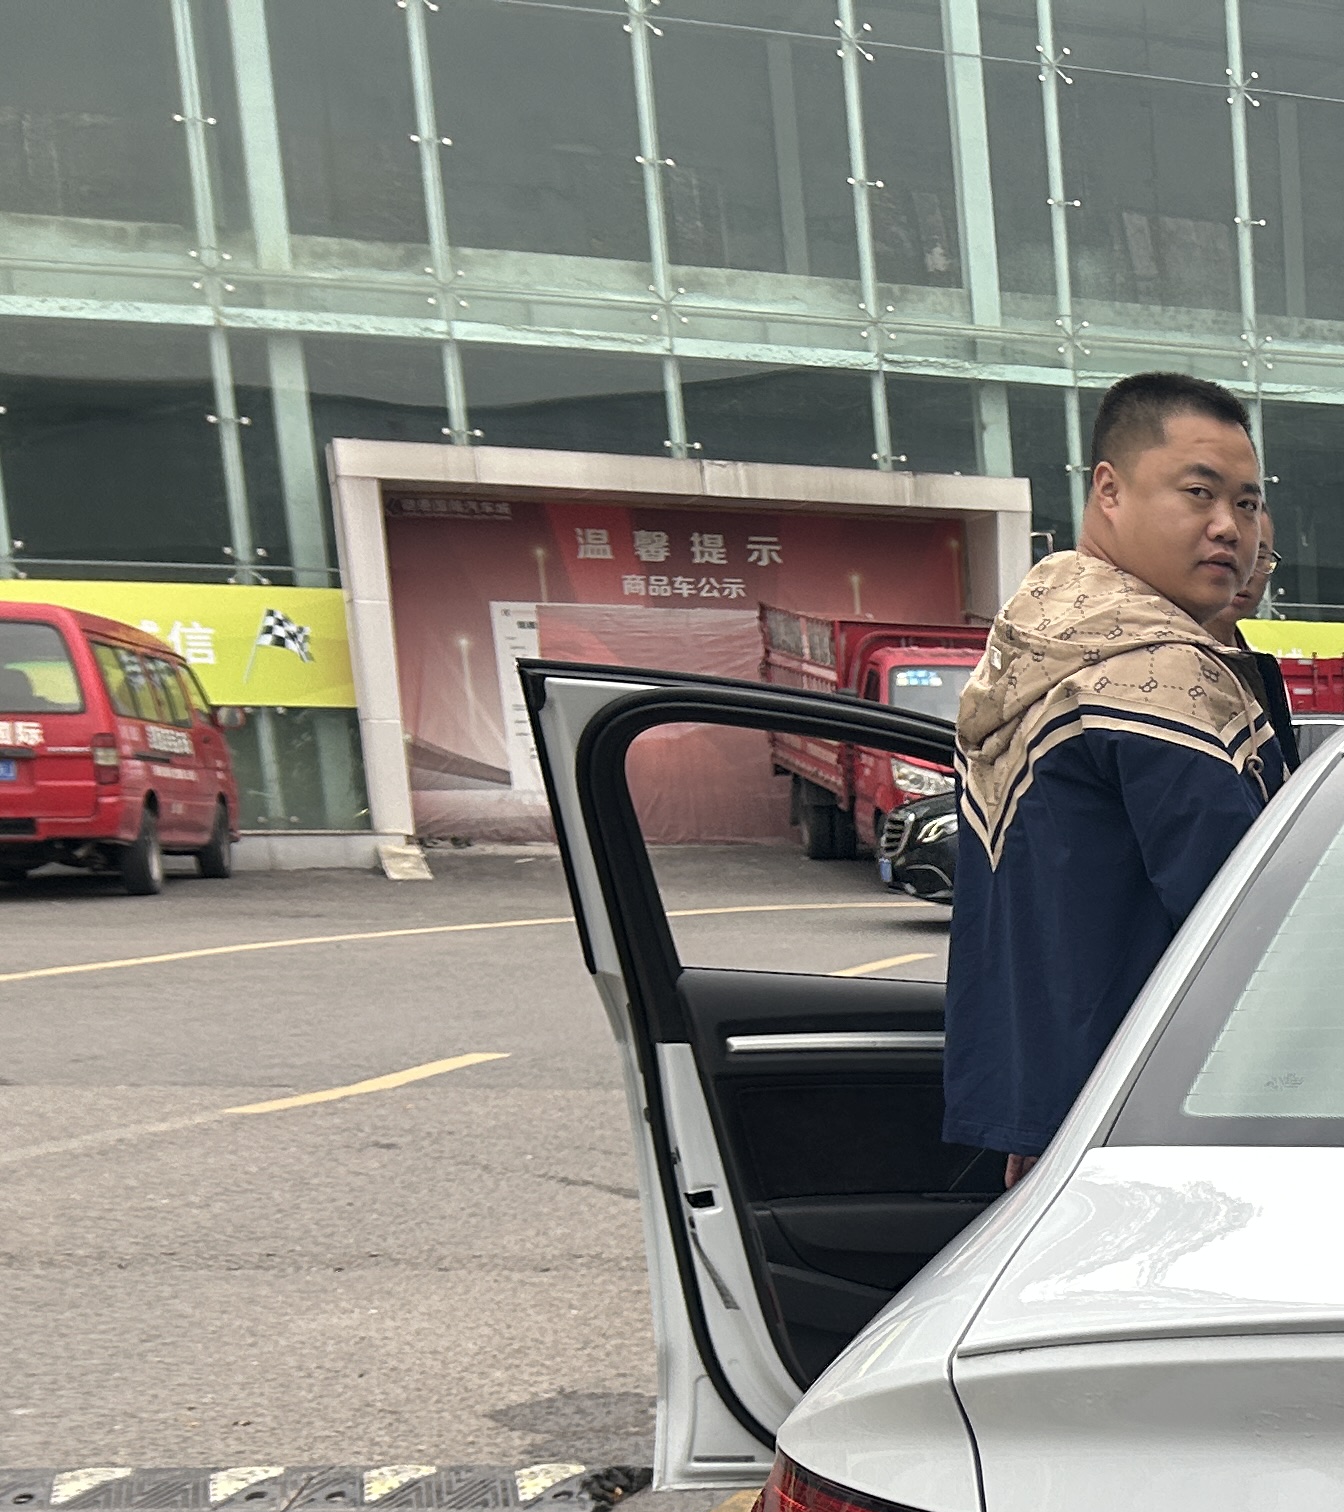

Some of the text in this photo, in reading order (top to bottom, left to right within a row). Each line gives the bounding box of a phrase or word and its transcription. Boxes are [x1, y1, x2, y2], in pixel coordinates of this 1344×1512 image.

[575, 527, 784, 567] 温馨提示
[621, 574, 748, 599] 商品车公示
